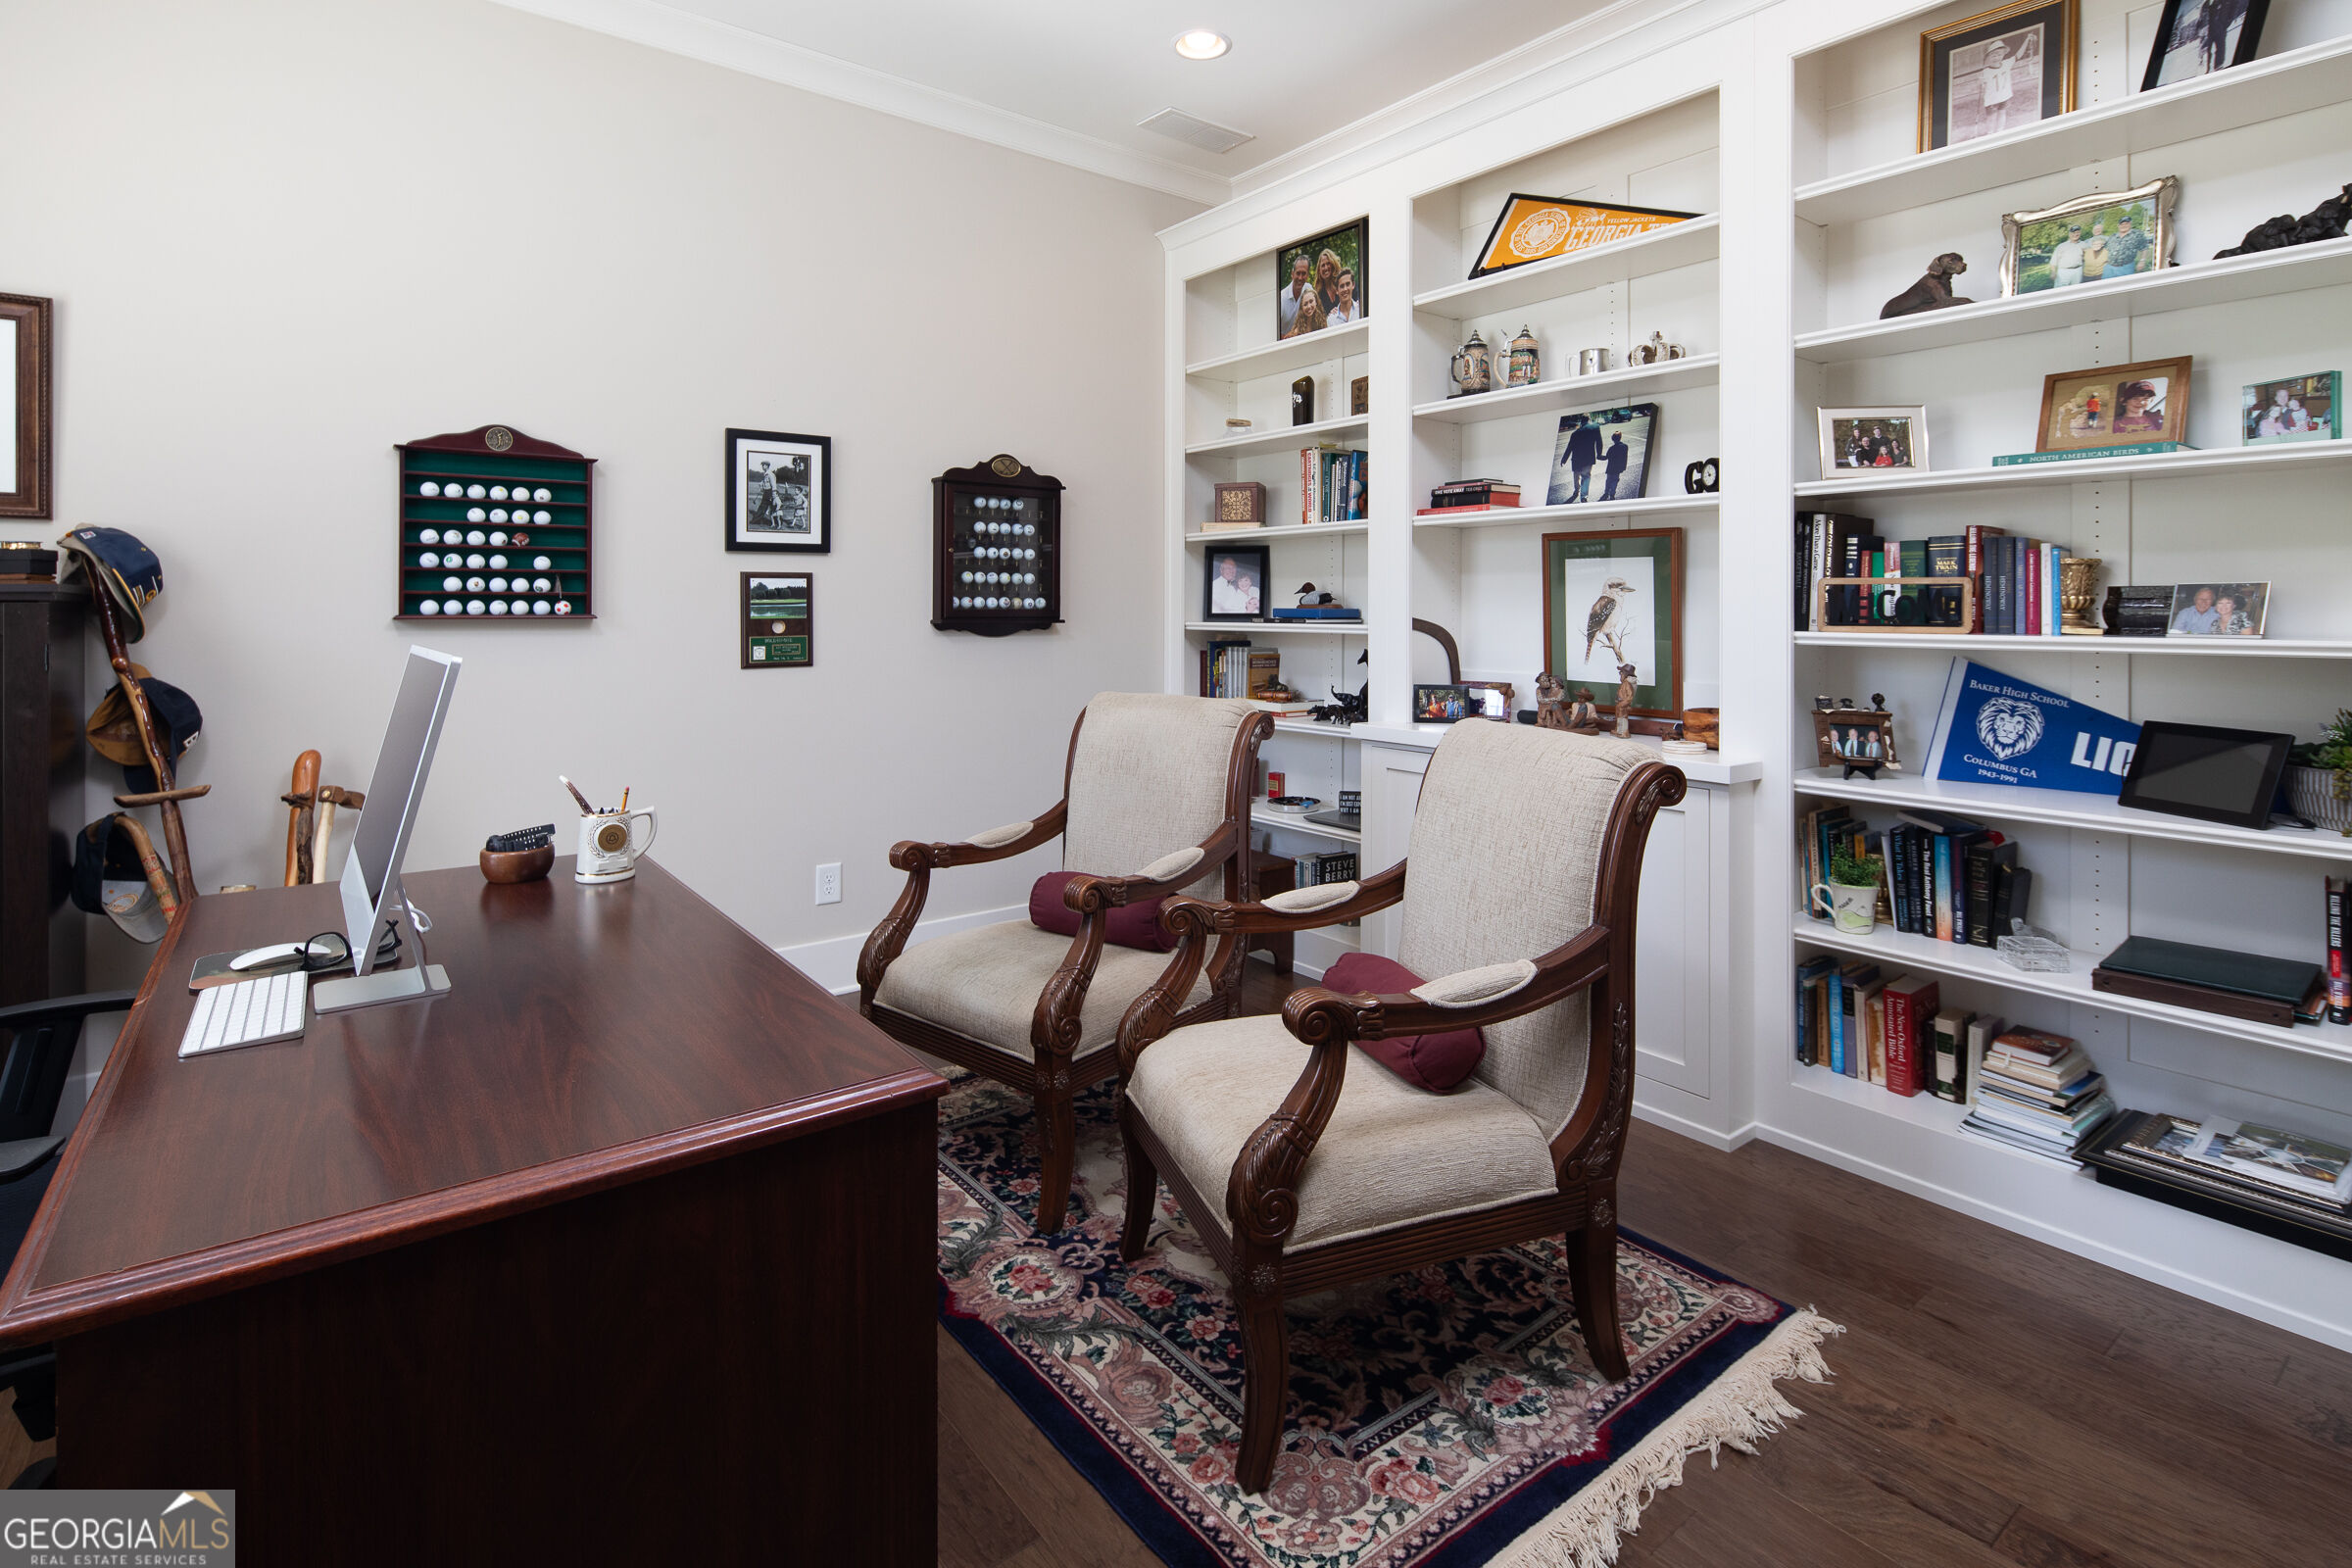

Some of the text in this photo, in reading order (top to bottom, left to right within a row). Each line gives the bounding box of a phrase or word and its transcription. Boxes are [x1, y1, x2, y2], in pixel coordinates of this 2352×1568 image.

[1563, 223, 1642, 251] GEORGIA
[2030, 448, 2139, 463] NORTH AMERICAN BIRDS
[1969, 679, 2070, 708] BAKER HIGH SCHOOL
[1963, 754, 2038, 779] COLUMBUS GA
[1978, 768, 2018, 784] 1943-1991
[1325, 869, 1354, 882] BERRY
[1326, 859, 1354, 872] STEVE
[2330, 895, 2340, 915] KILLING
[2331, 916, 2341, 926] THE
[2331, 926, 2342, 947] KILLERS
[1887, 995, 1897, 1059] Annotated Bible
[1898, 1033, 1906, 1062] Oxford
